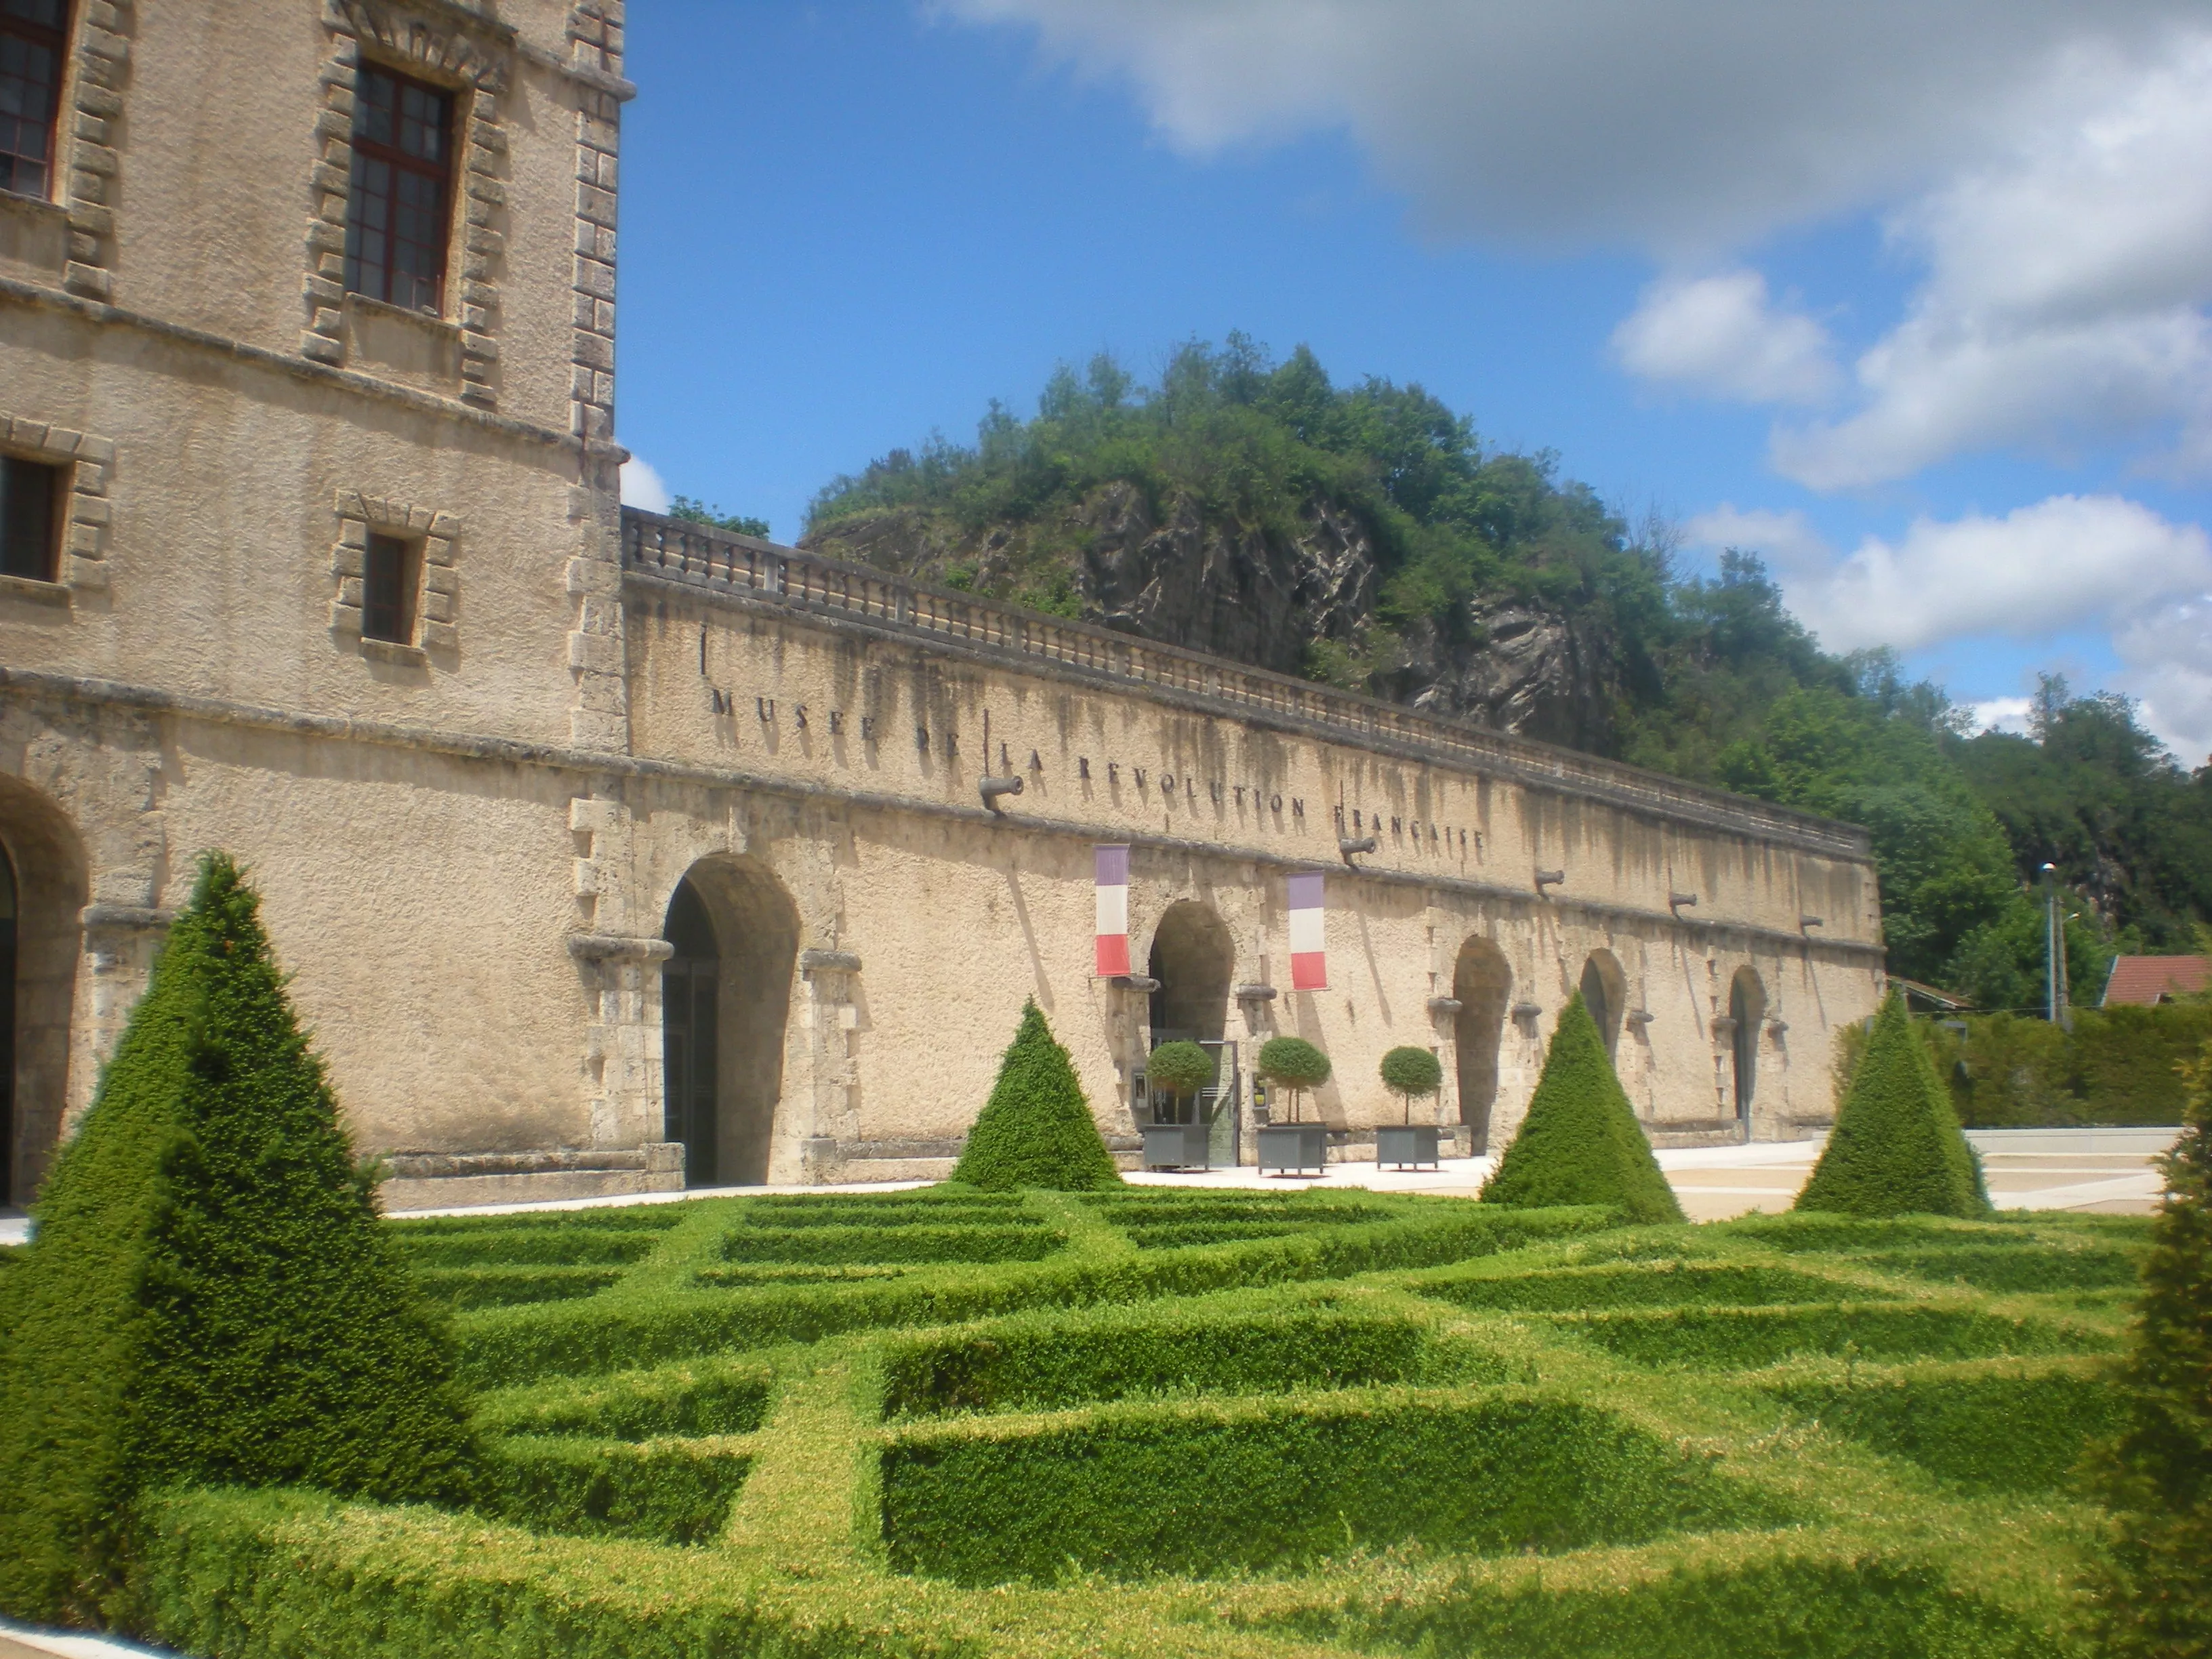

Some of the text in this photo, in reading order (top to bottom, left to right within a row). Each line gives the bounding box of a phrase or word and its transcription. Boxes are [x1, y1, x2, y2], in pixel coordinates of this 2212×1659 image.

[712, 689, 875, 741] MUSEE
[916, 726, 960, 758] DE
[1000, 743, 1044, 771] LA
[1079, 756, 1305, 817] REVOLUTION
